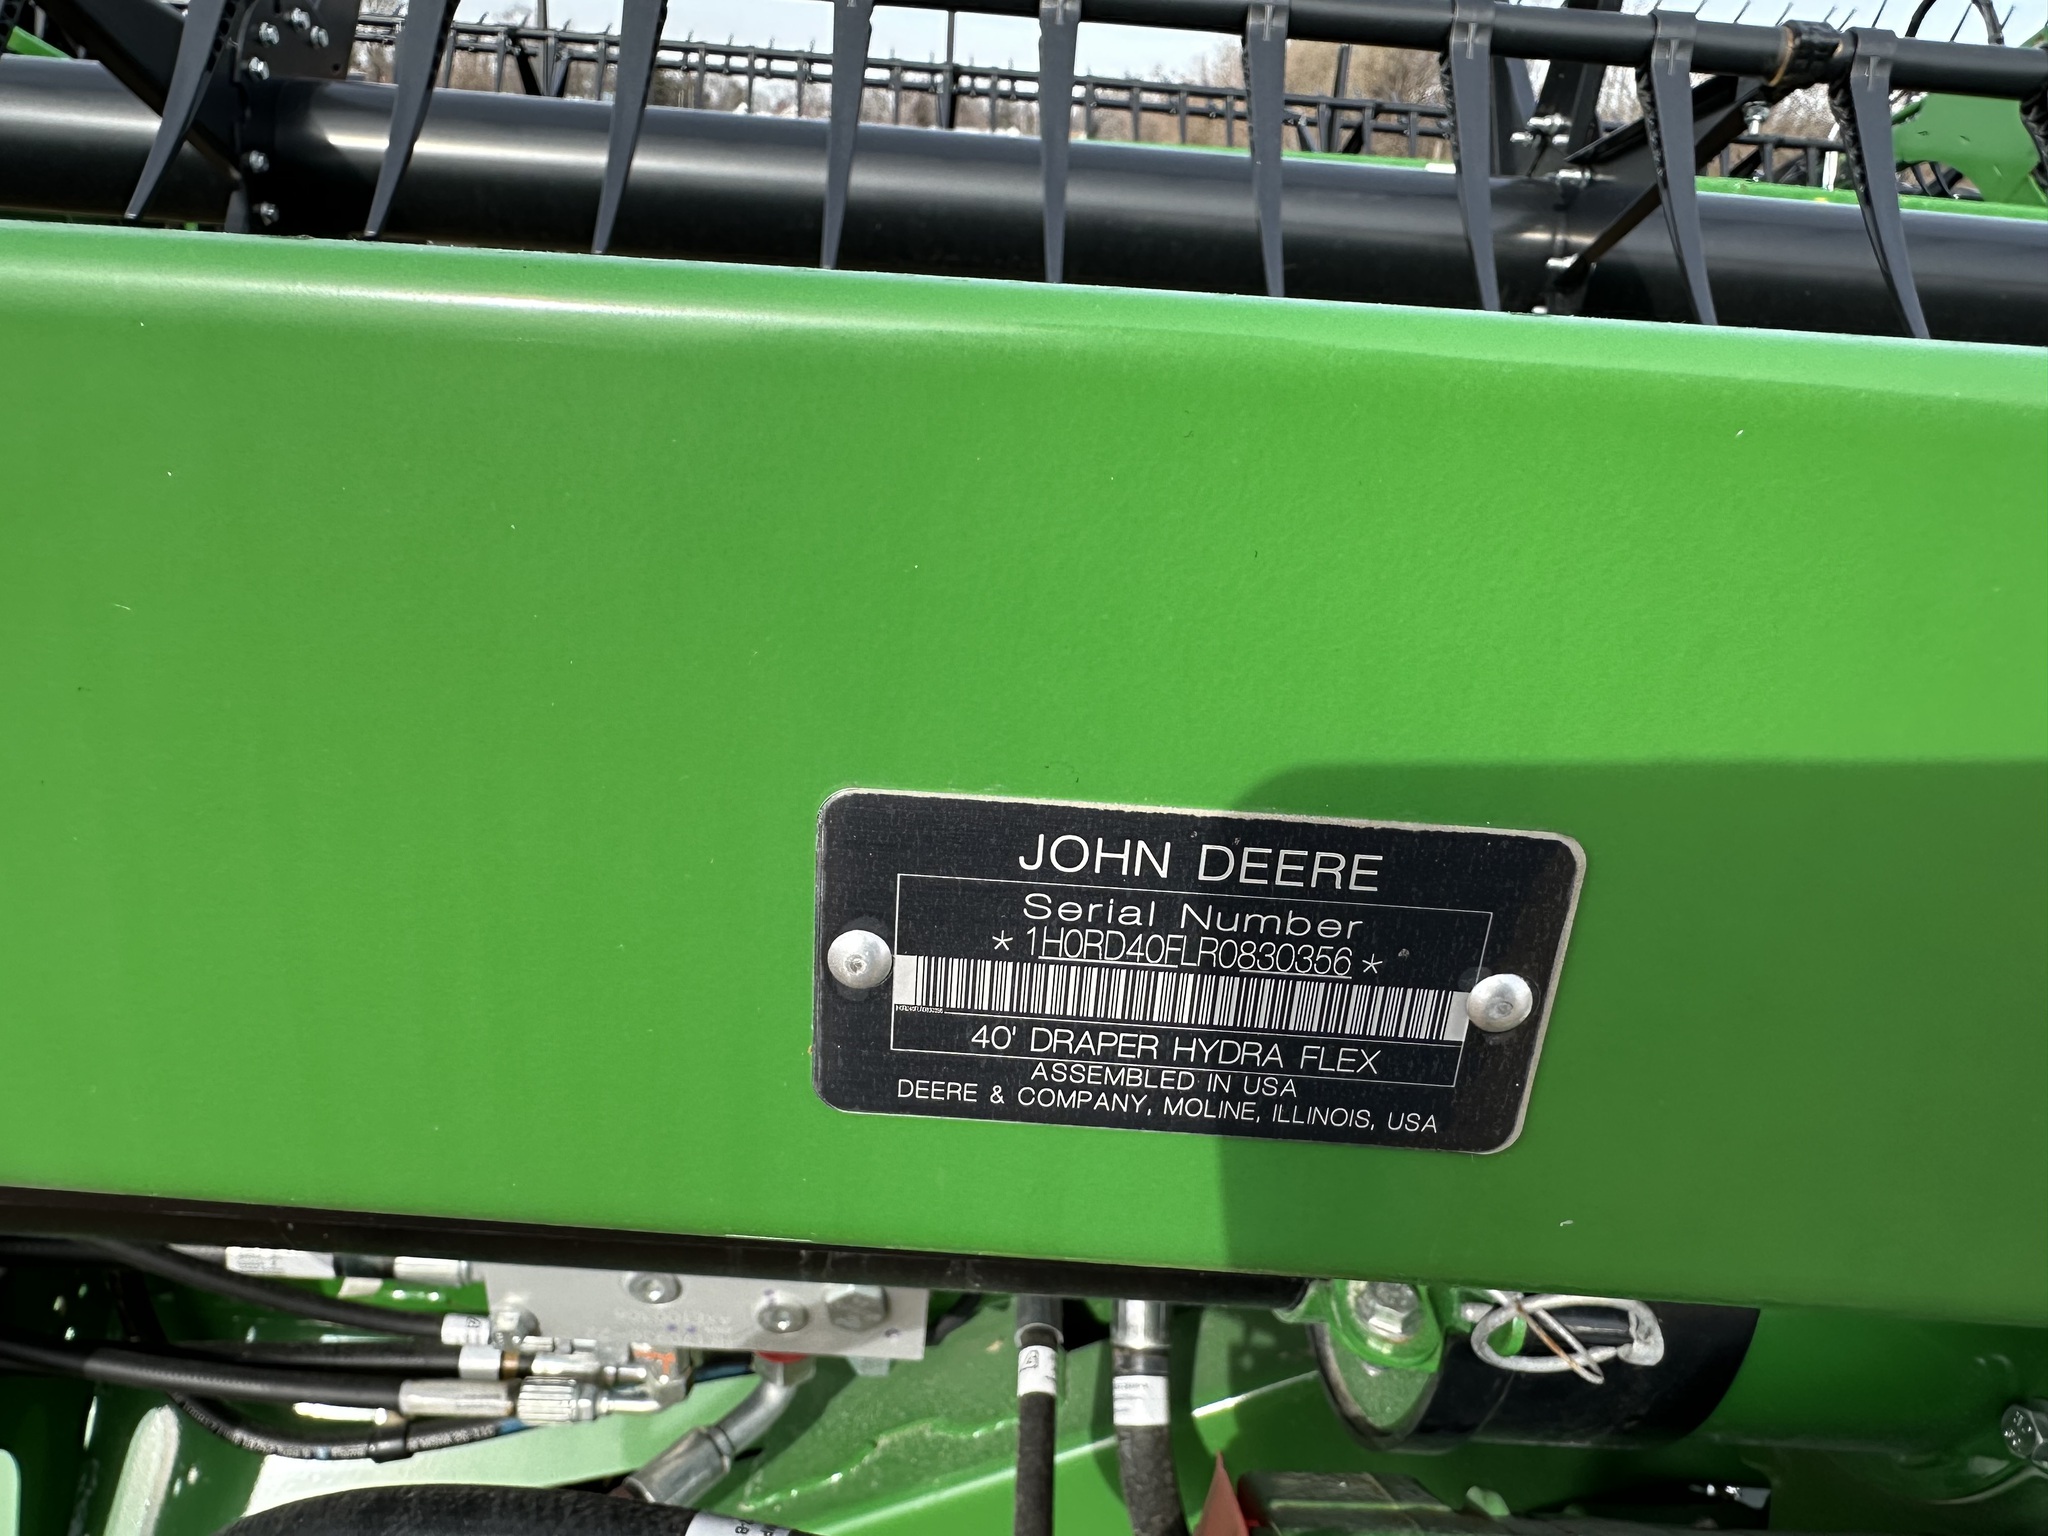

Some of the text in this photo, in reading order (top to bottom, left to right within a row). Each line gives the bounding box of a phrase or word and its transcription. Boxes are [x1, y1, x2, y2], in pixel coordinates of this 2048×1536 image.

[1018, 833, 1384, 892] JOHN DEERE
[1022, 893, 1363, 939] Serial Number
[1030, 1027, 1159, 1060] DRAPER
[1173, 1037, 1284, 1069] HYDRA
[1299, 1046, 1382, 1075] FLEX
[1030, 1061, 1298, 1098] ASSEMBLED IN USA
[897, 1079, 1438, 1134] DEERE & COMPANY, MOLINE, ILLINOIS, USA
